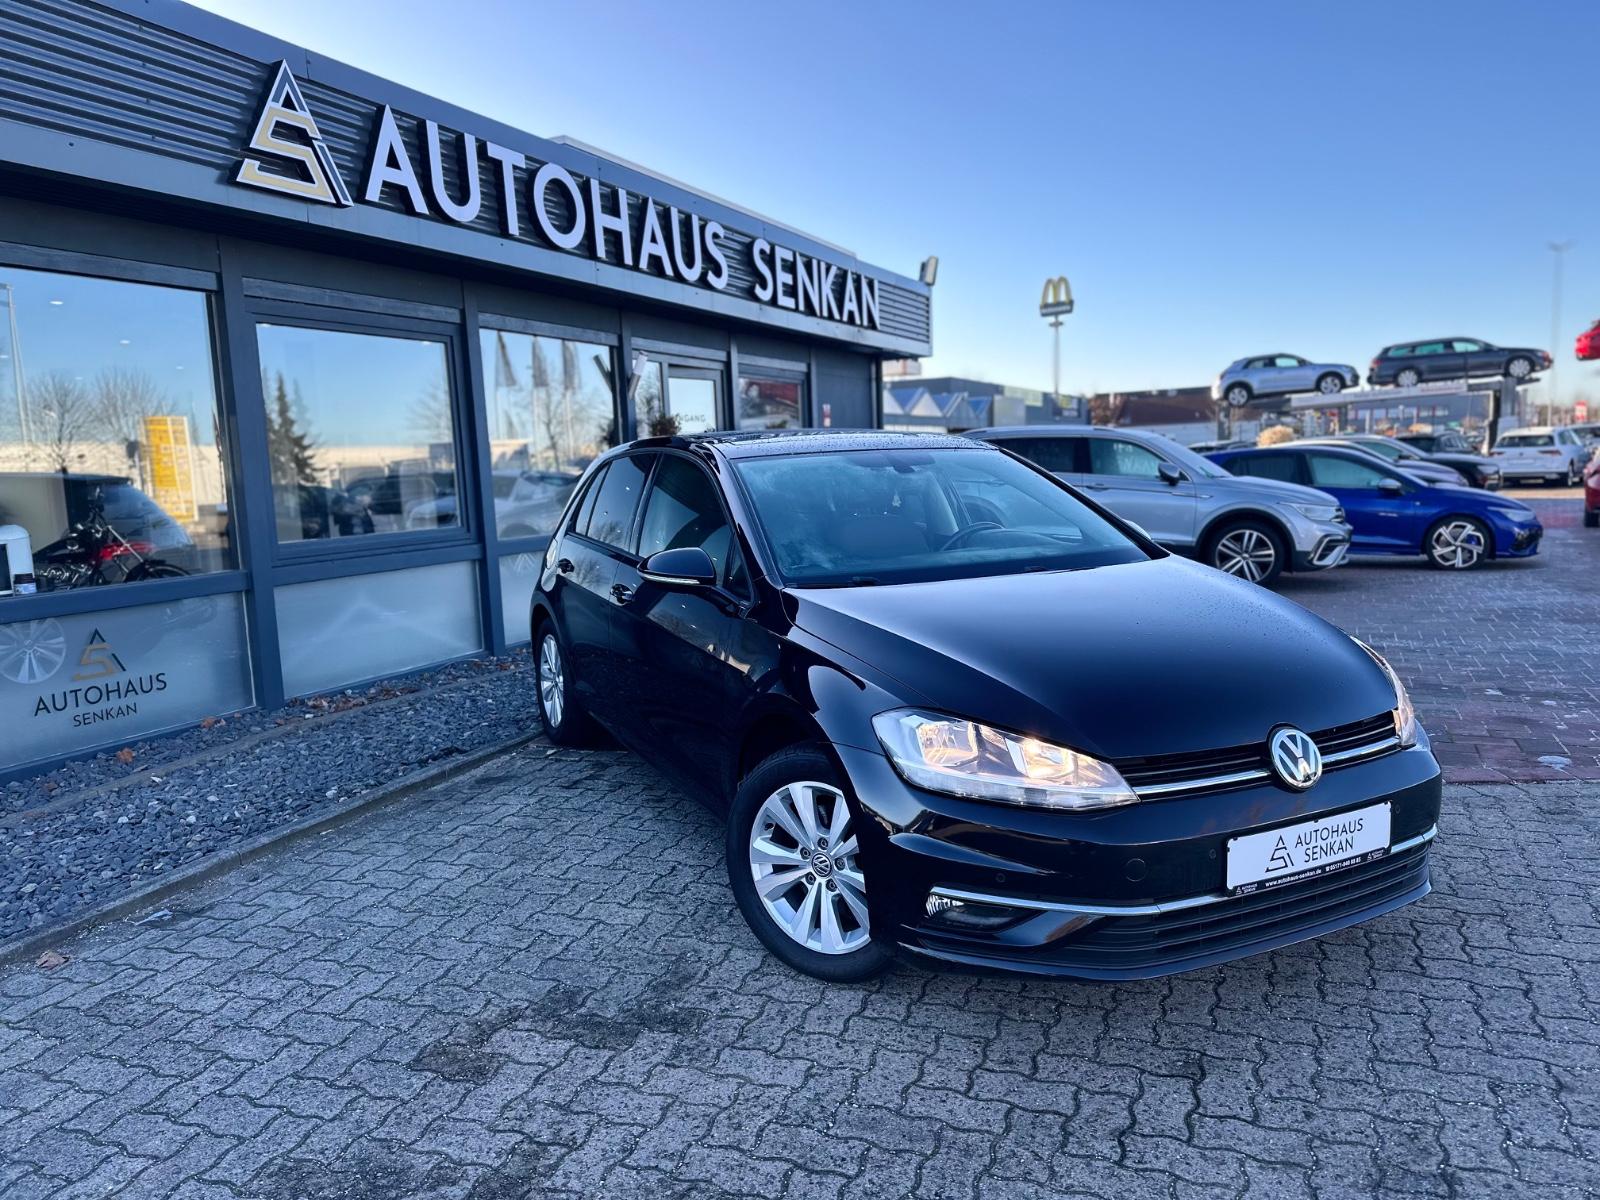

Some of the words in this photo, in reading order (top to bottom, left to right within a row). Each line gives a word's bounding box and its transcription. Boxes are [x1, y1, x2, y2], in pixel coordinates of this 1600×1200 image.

[364, 104, 728, 290] AUTOHAUS
[752, 238, 880, 330] SENKAN
[34, 672, 168, 717] AUTOHAUS
[73, 702, 138, 728] SENKAN
[1294, 818, 1364, 849] AUTOHAUS
[1304, 836, 1354, 863] SENKAN
[1265, 868, 1322, 887] www.autohaus-senkan.de
